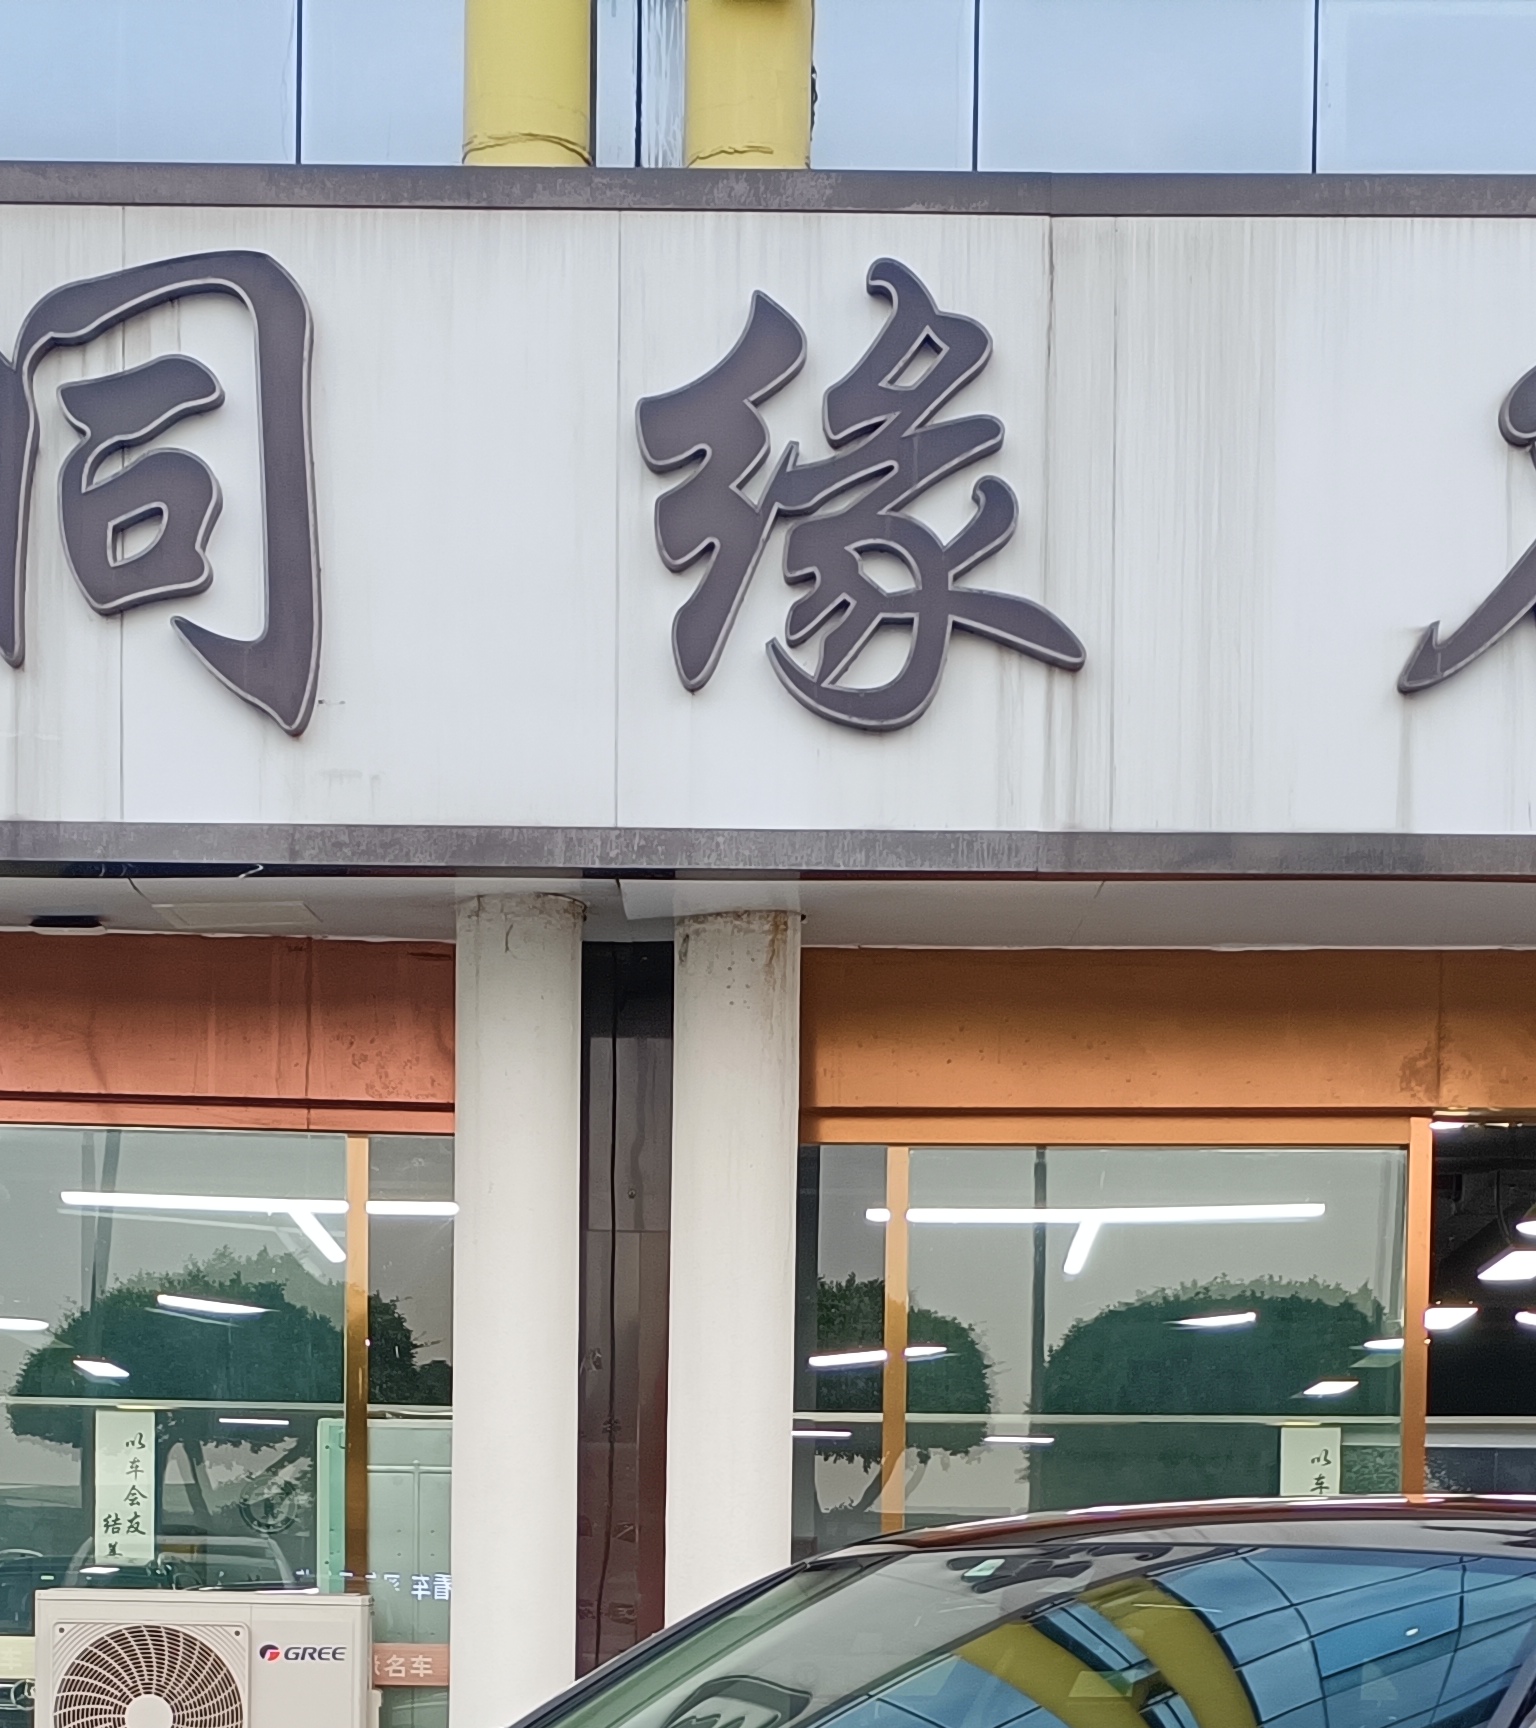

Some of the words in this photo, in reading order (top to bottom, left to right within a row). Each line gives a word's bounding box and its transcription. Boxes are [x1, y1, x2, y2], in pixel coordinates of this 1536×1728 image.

[123, 1432, 148, 1535] 以车会友
[1309, 1448, 1332, 1495] 以车
[284, 1646, 348, 1661] GREE
